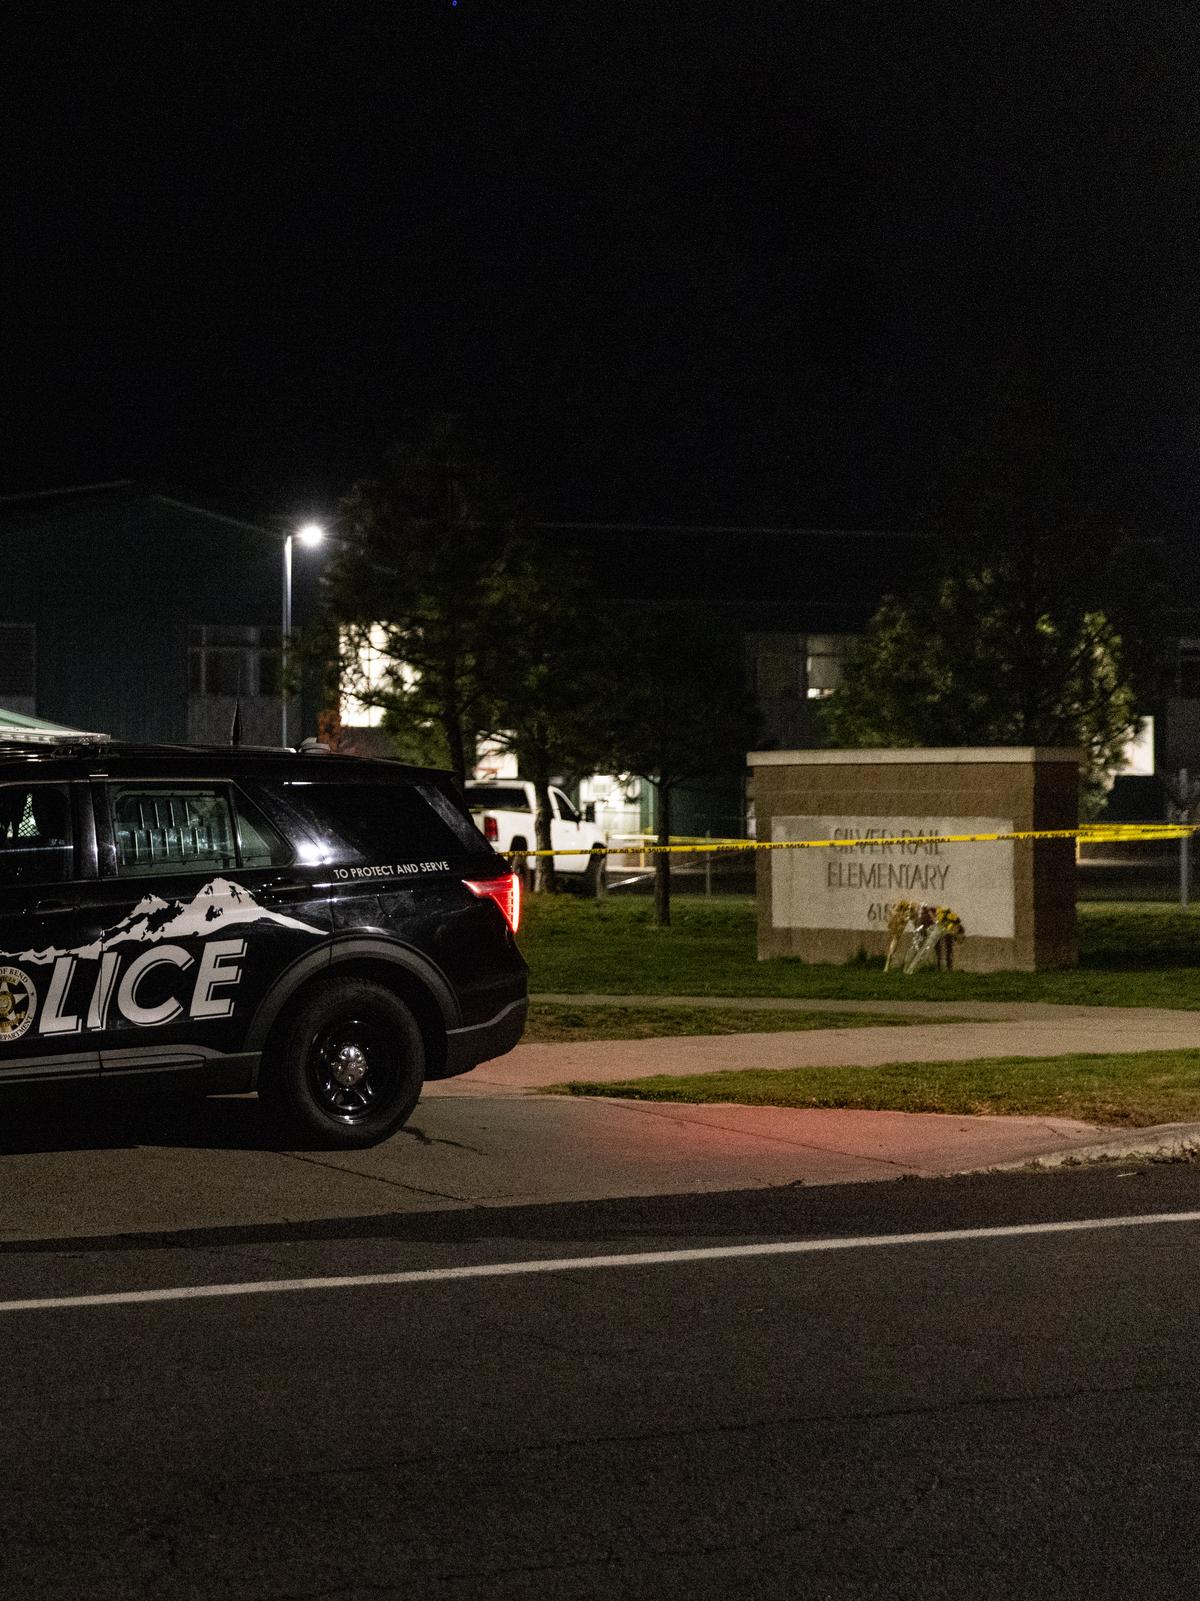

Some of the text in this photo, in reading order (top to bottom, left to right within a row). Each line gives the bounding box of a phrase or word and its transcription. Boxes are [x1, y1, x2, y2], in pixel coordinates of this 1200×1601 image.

[901, 828, 943, 855] RAIL
[333, 861, 450, 879] TO PROTECT AND SERVE
[827, 862, 950, 890] ELEMENTARY
[8, 968, 29, 984] BEND
